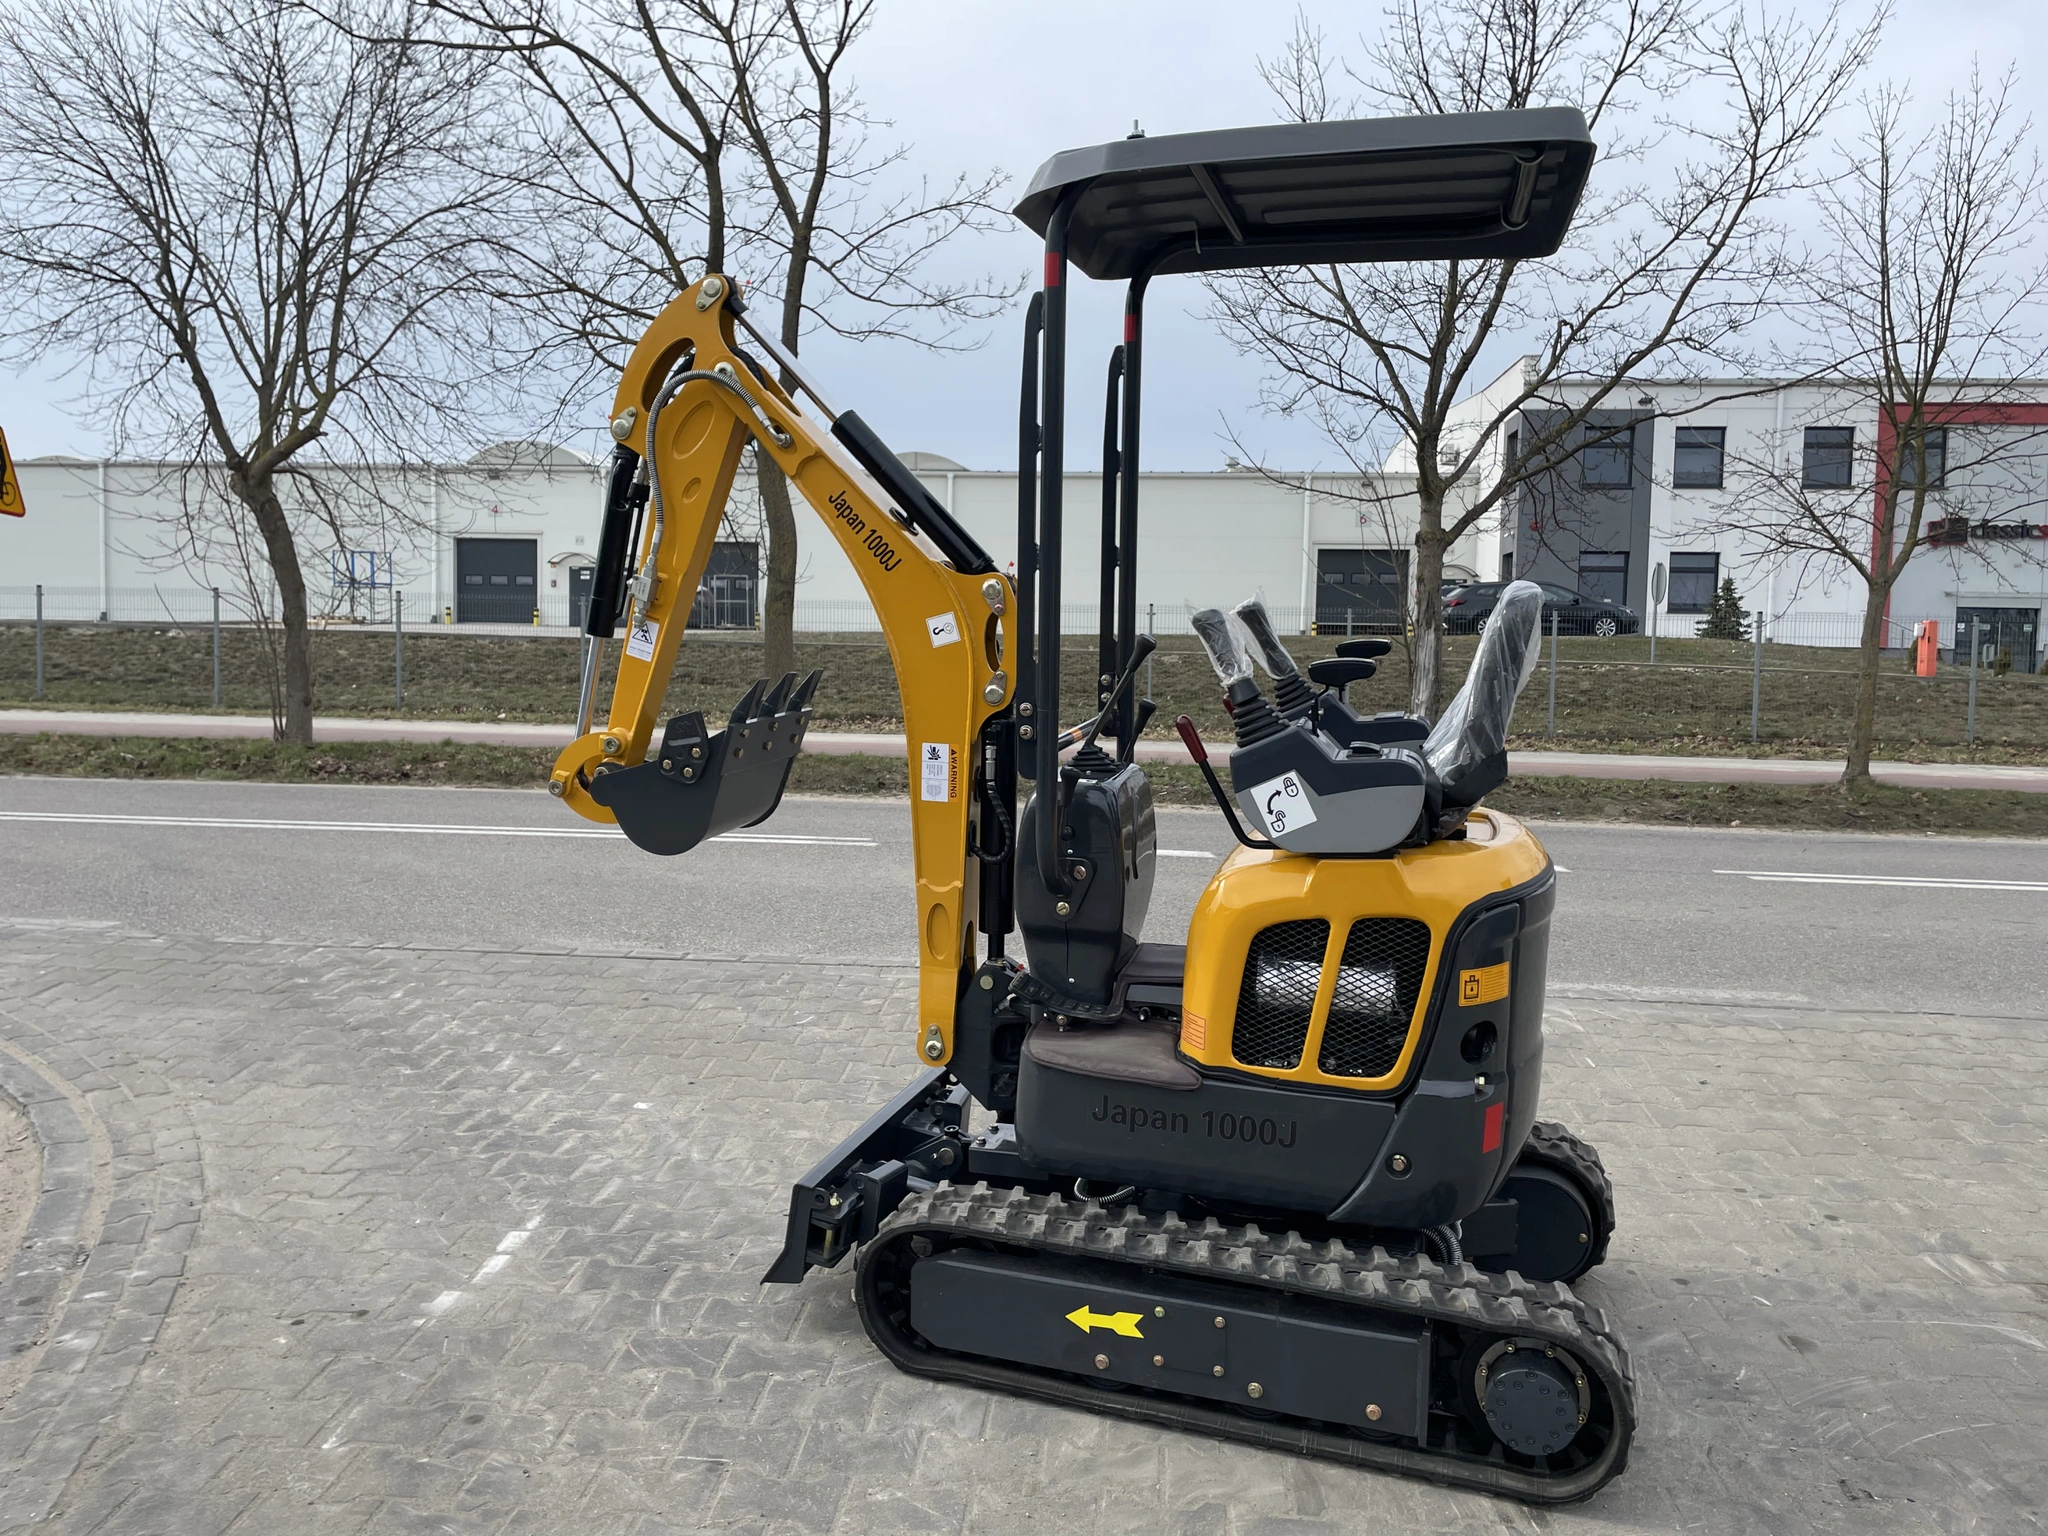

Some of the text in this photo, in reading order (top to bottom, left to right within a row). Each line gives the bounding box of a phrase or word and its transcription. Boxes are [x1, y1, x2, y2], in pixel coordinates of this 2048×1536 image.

[491, 504, 499, 514] 4
[1360, 514, 1368, 524] 6
[828, 490, 902, 572] Japan 1000J
[950, 757, 958, 799] WARNING
[1091, 1095, 1297, 1149] Japan 1000J
